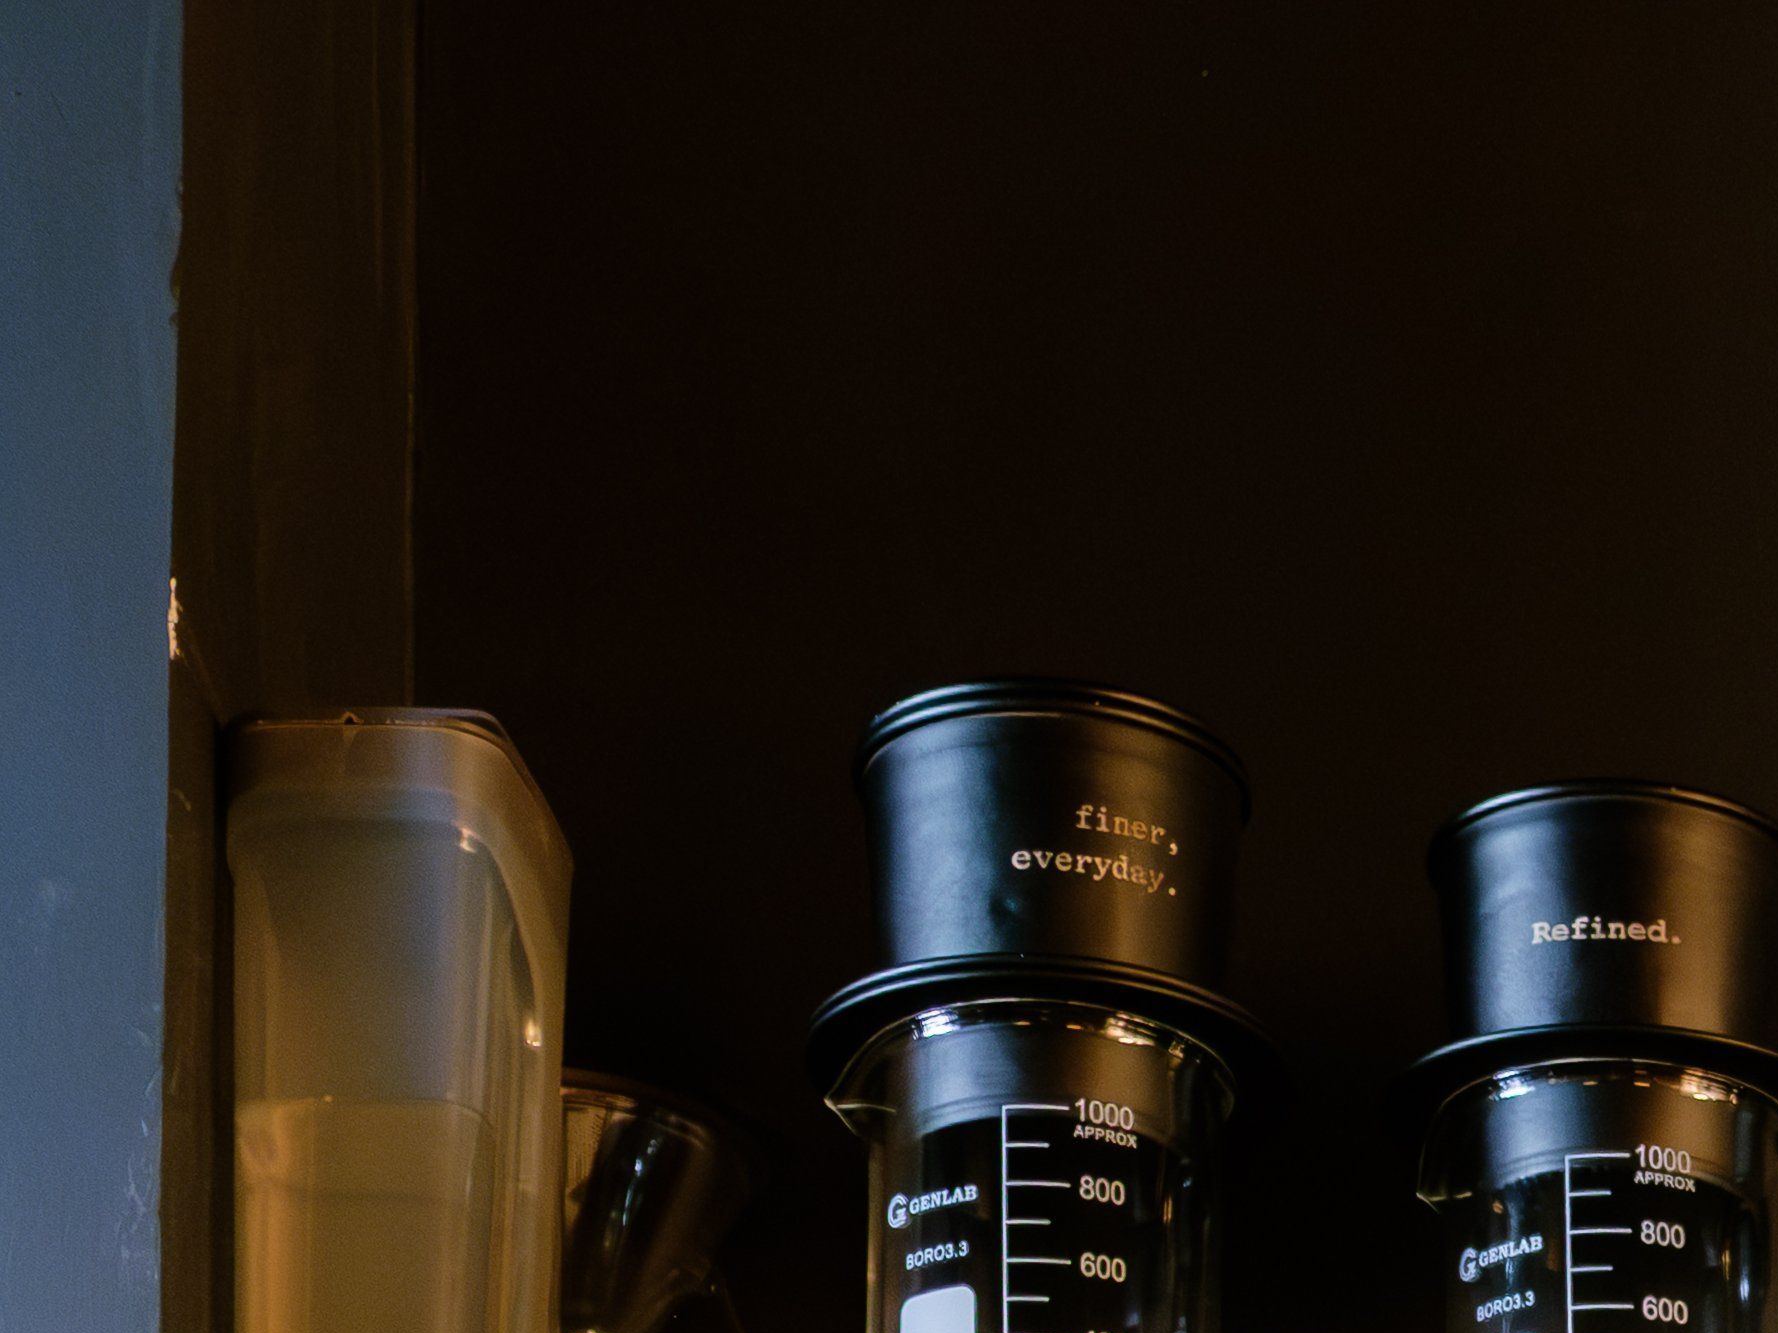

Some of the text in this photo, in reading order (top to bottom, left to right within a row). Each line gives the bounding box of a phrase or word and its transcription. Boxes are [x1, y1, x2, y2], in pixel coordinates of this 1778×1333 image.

[1075, 804, 1179, 856] finer,
[1011, 848, 1176, 896] everyday.
[1531, 916, 1682, 945] Refined.
[1075, 1098, 1135, 1131] 1000
[1073, 1124, 1138, 1149] APPROX
[1634, 1144, 1691, 1175] 1000
[1079, 1175, 1126, 1206] 800
[1634, 1170, 1696, 1193] APPROX
[909, 1185, 979, 1214] GENLAB
[1639, 1221, 1686, 1249] 800
[1479, 1235, 1544, 1267] GENLAB
[1080, 1252, 1127, 1283] 600
[1641, 1296, 1688, 1325] 600
